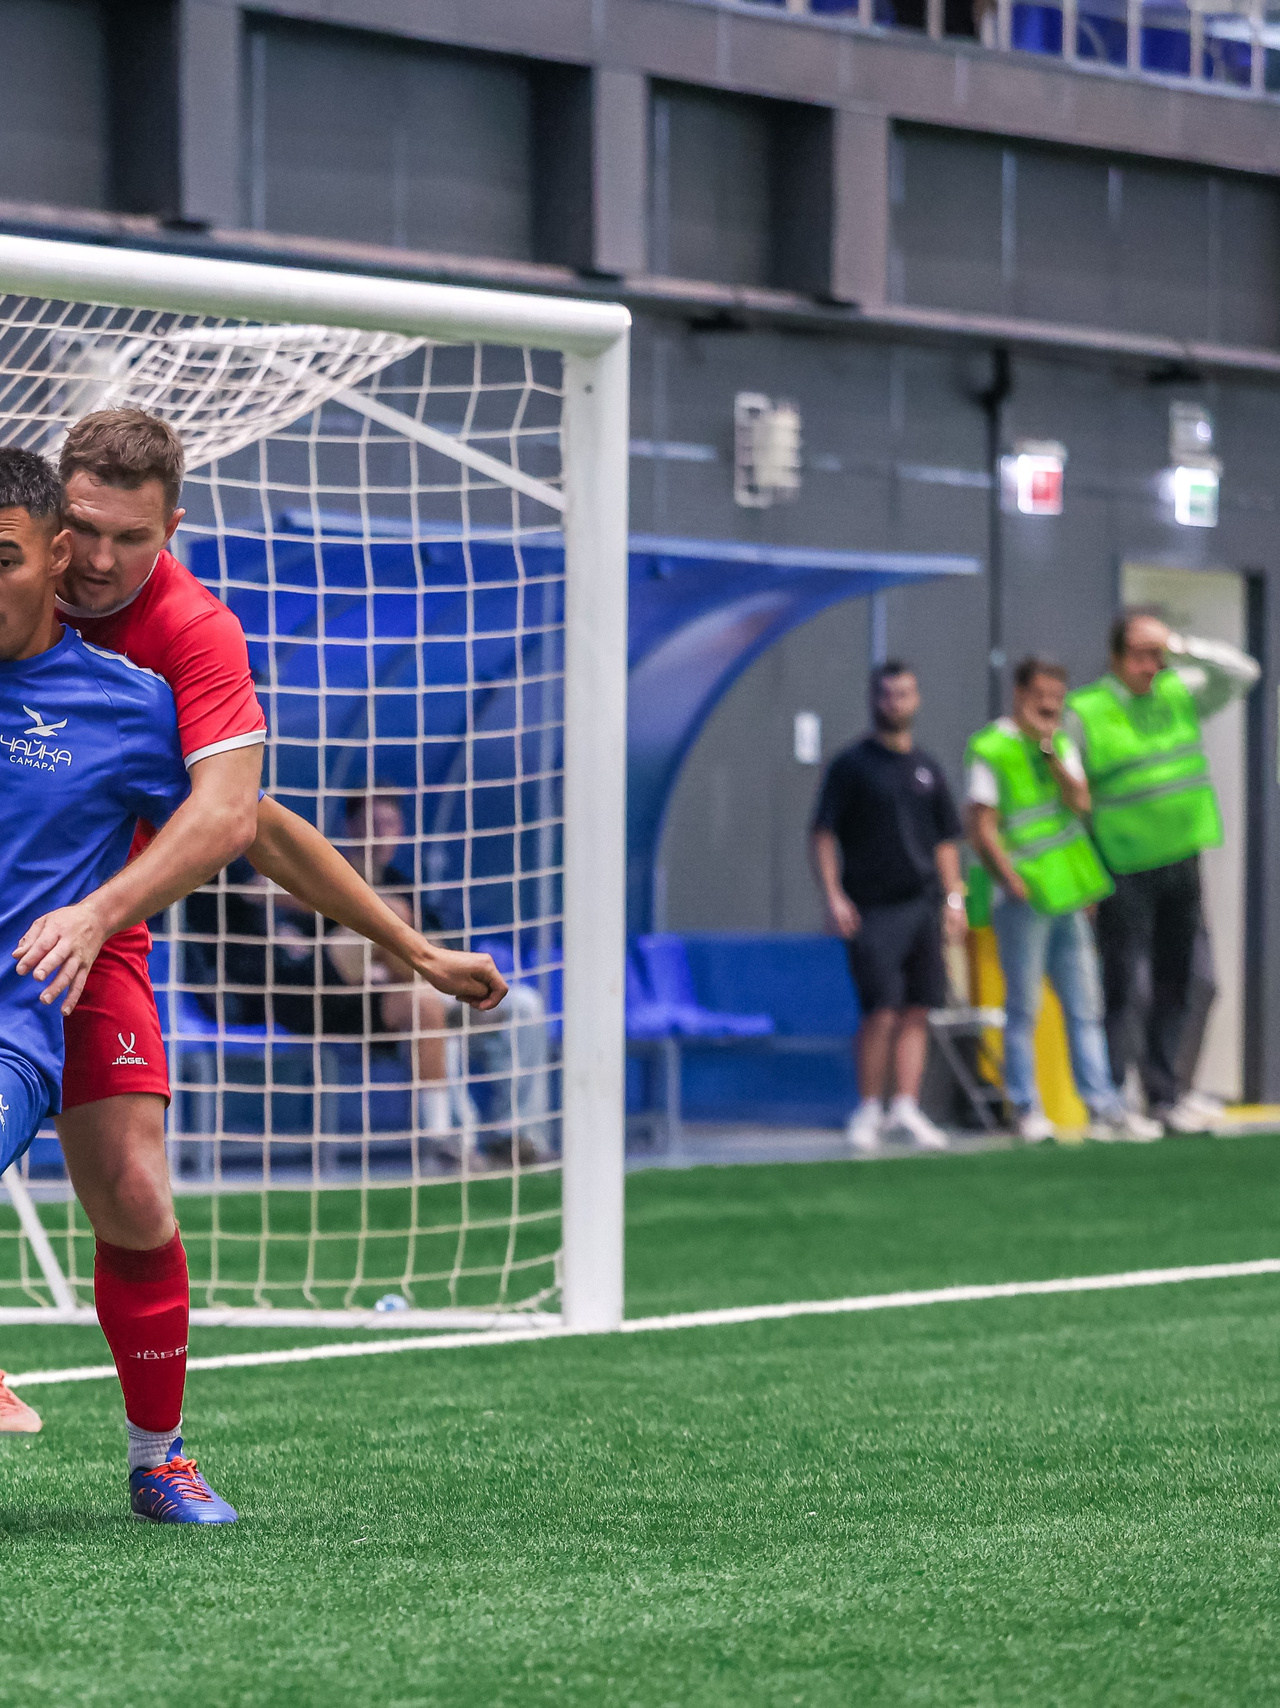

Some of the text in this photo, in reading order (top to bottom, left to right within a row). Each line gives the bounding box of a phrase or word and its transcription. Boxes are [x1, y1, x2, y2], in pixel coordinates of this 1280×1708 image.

[0, 734, 72, 766] ЧАЙКА
[9, 754, 56, 773] САМАРА
[111, 1055, 149, 1065] JÖGEL
